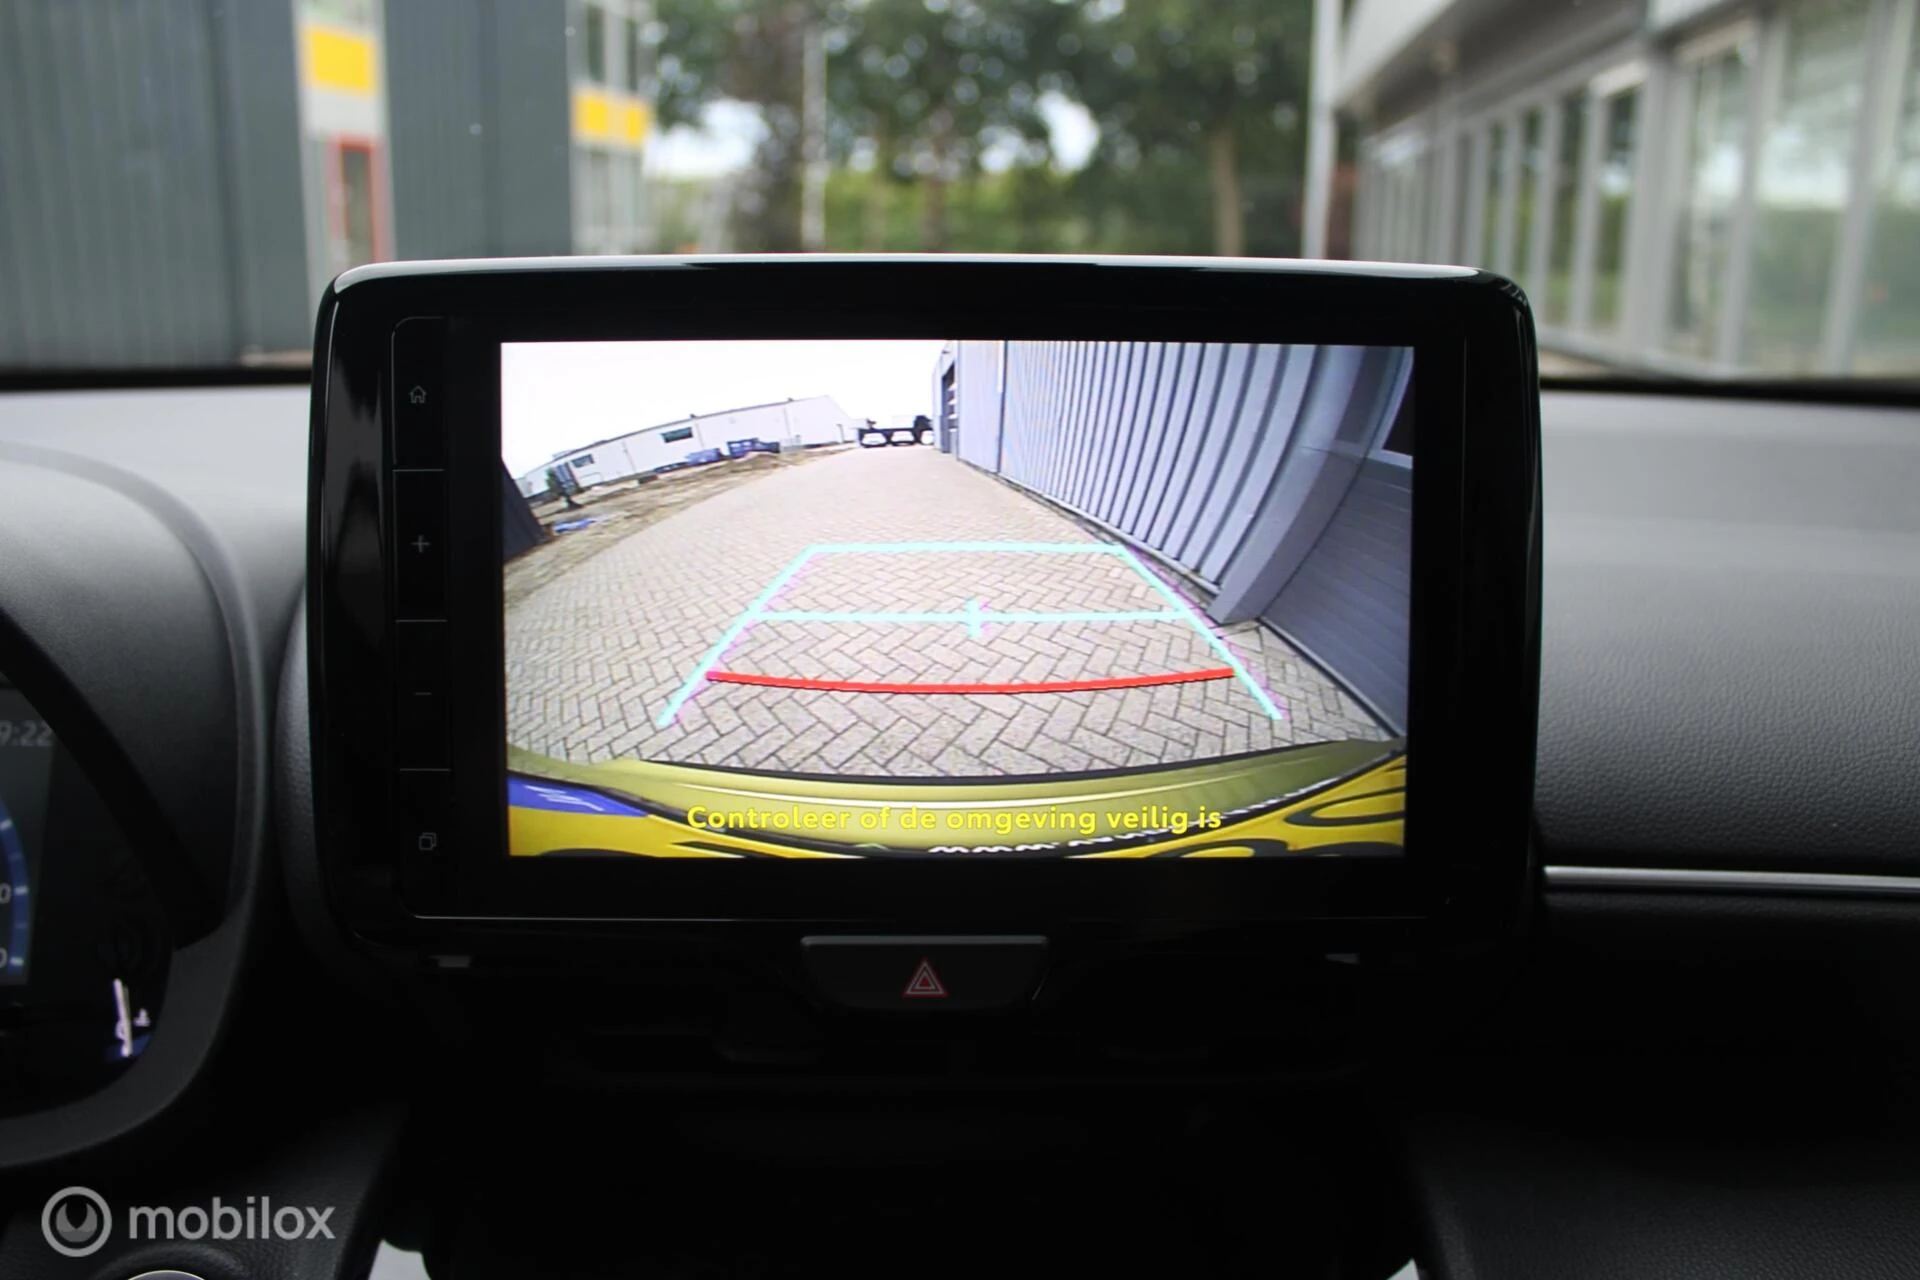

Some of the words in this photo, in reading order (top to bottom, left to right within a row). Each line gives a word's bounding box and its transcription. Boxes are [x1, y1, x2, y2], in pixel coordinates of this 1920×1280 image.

[687, 806, 849, 828] Controleer
[860, 806, 890, 828] of
[900, 806, 937, 828] de
[947, 806, 1097, 834] omgeving
[1106, 806, 1189, 834] veilig
[1199, 806, 1222, 828] is
